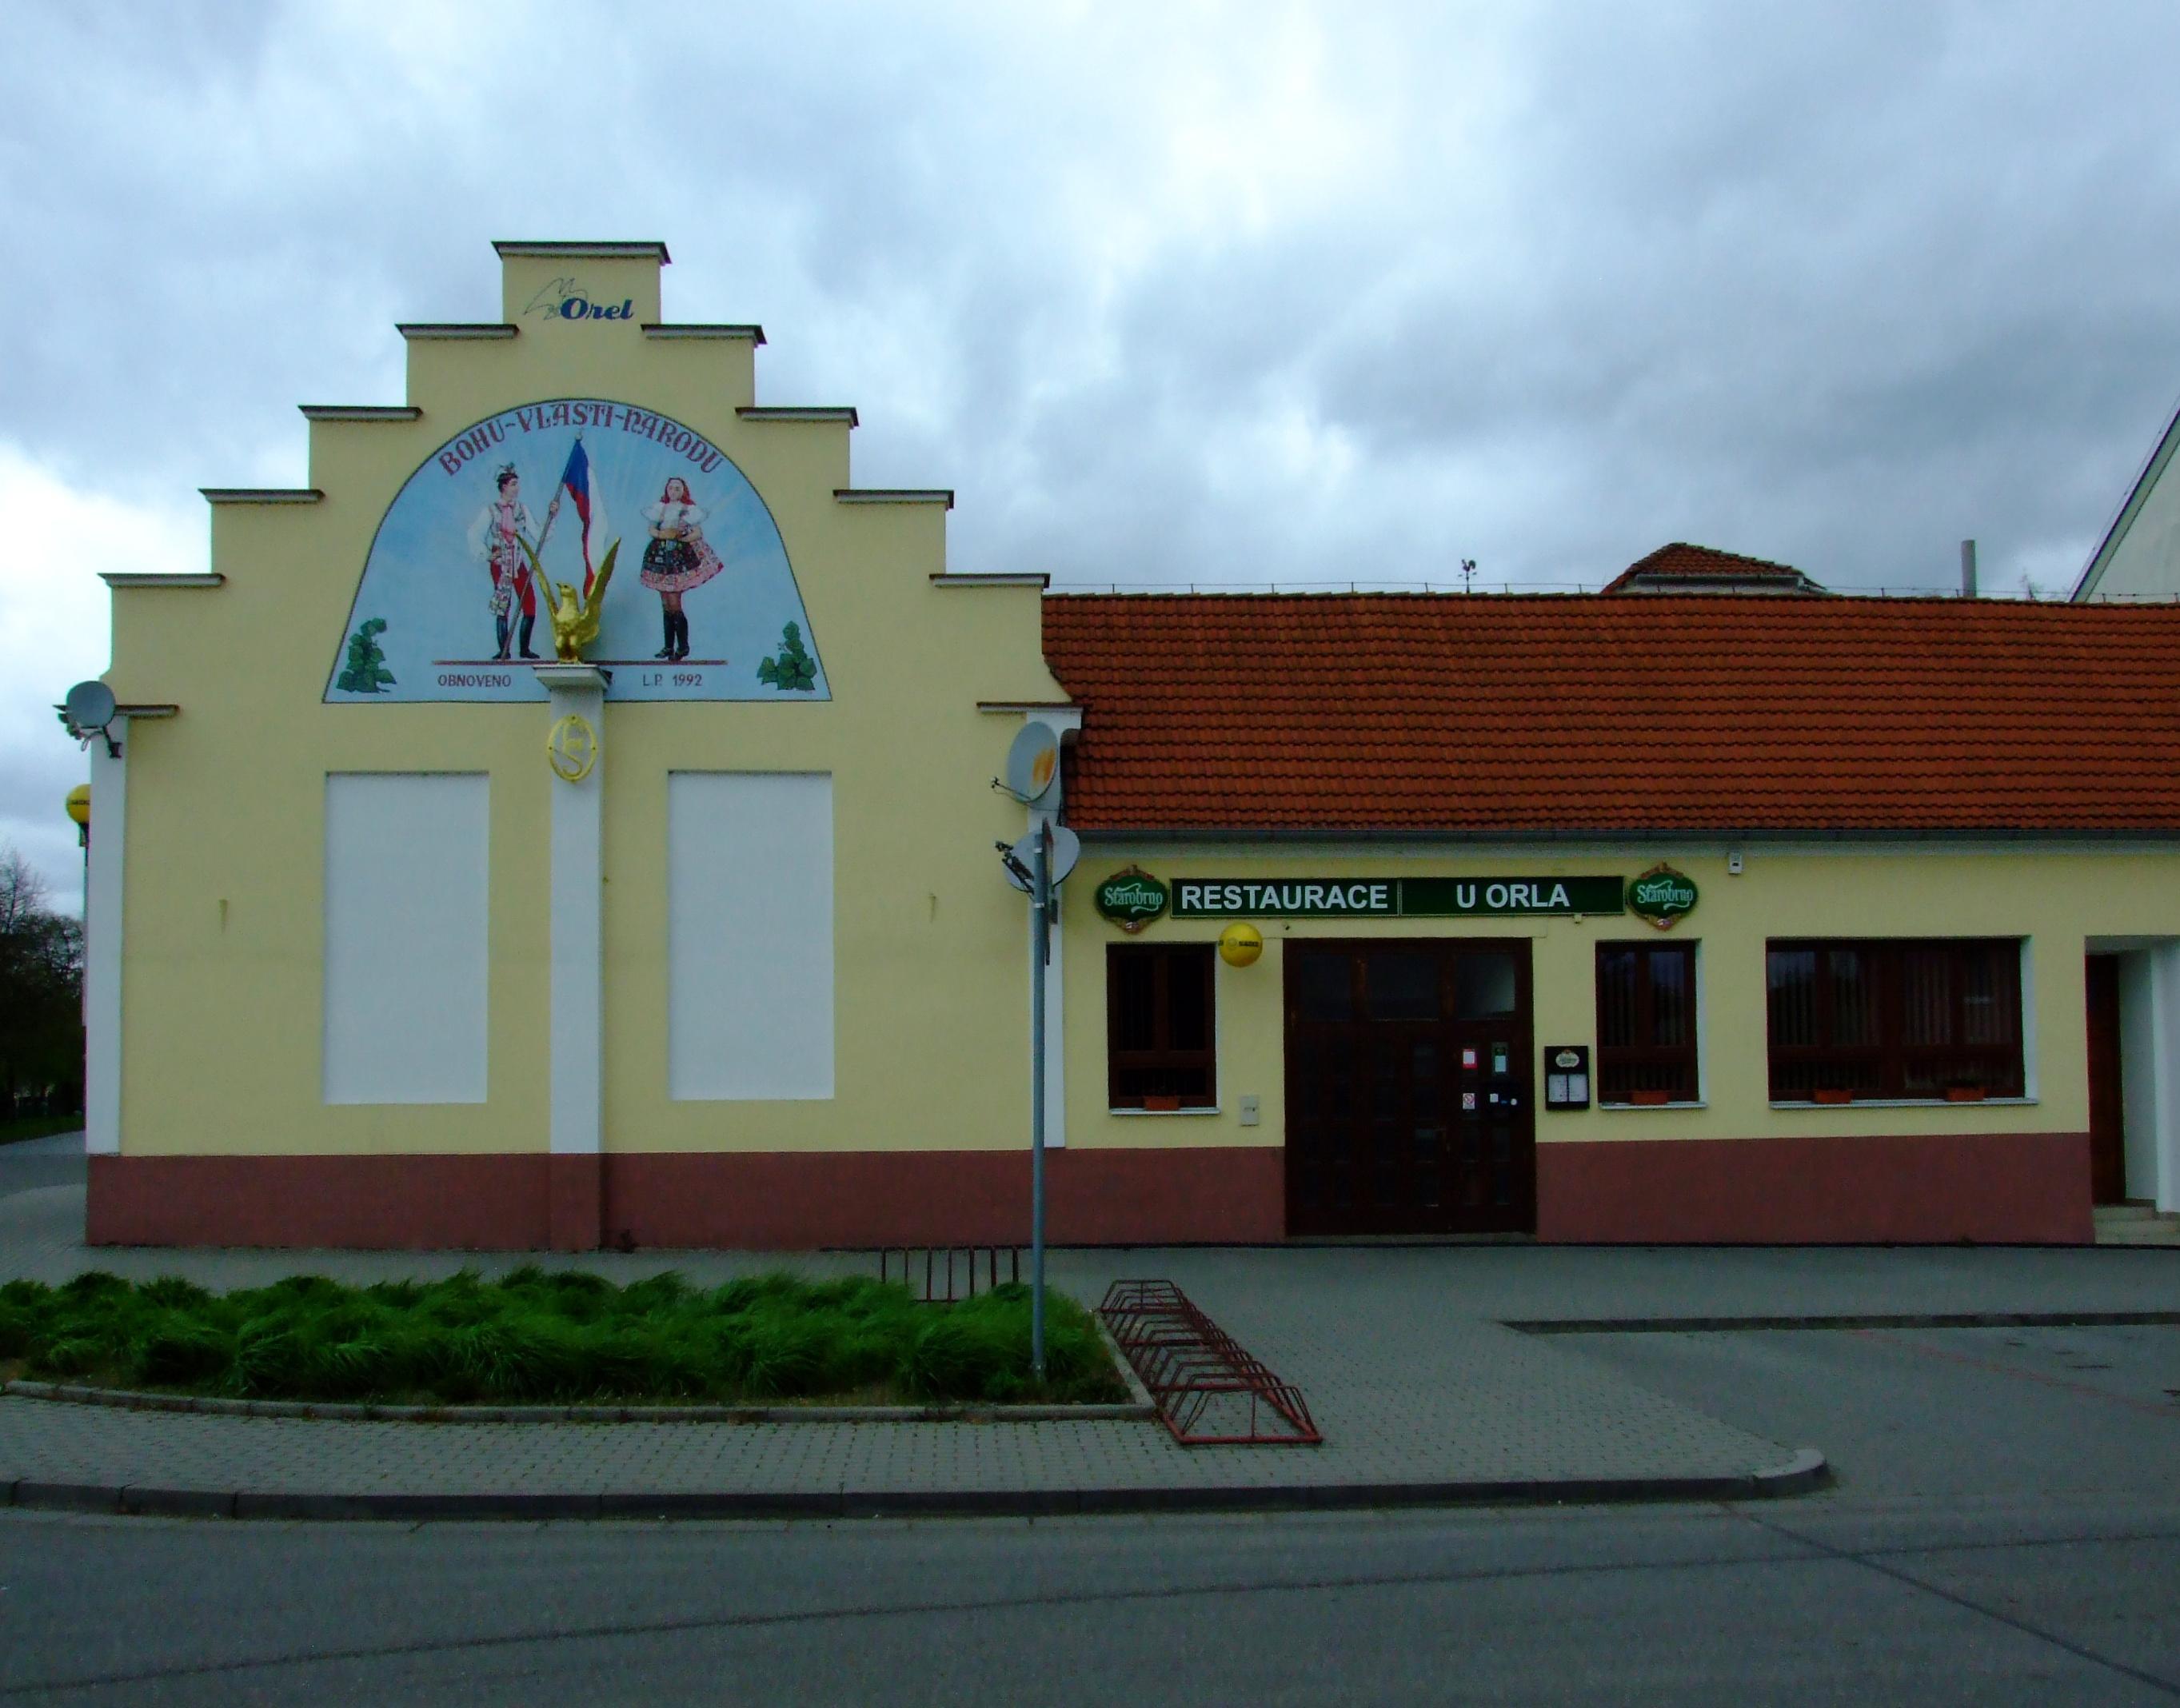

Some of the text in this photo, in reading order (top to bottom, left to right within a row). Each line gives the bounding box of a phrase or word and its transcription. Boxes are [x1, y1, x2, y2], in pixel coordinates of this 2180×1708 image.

[561, 297, 634, 320] Orel
[437, 673, 512, 688] OBNOVENO
[673, 673, 703, 687] 1992
[1104, 883, 1164, 913] Starobrno
[1181, 884, 1570, 910] RESTAURACE U ORLA
